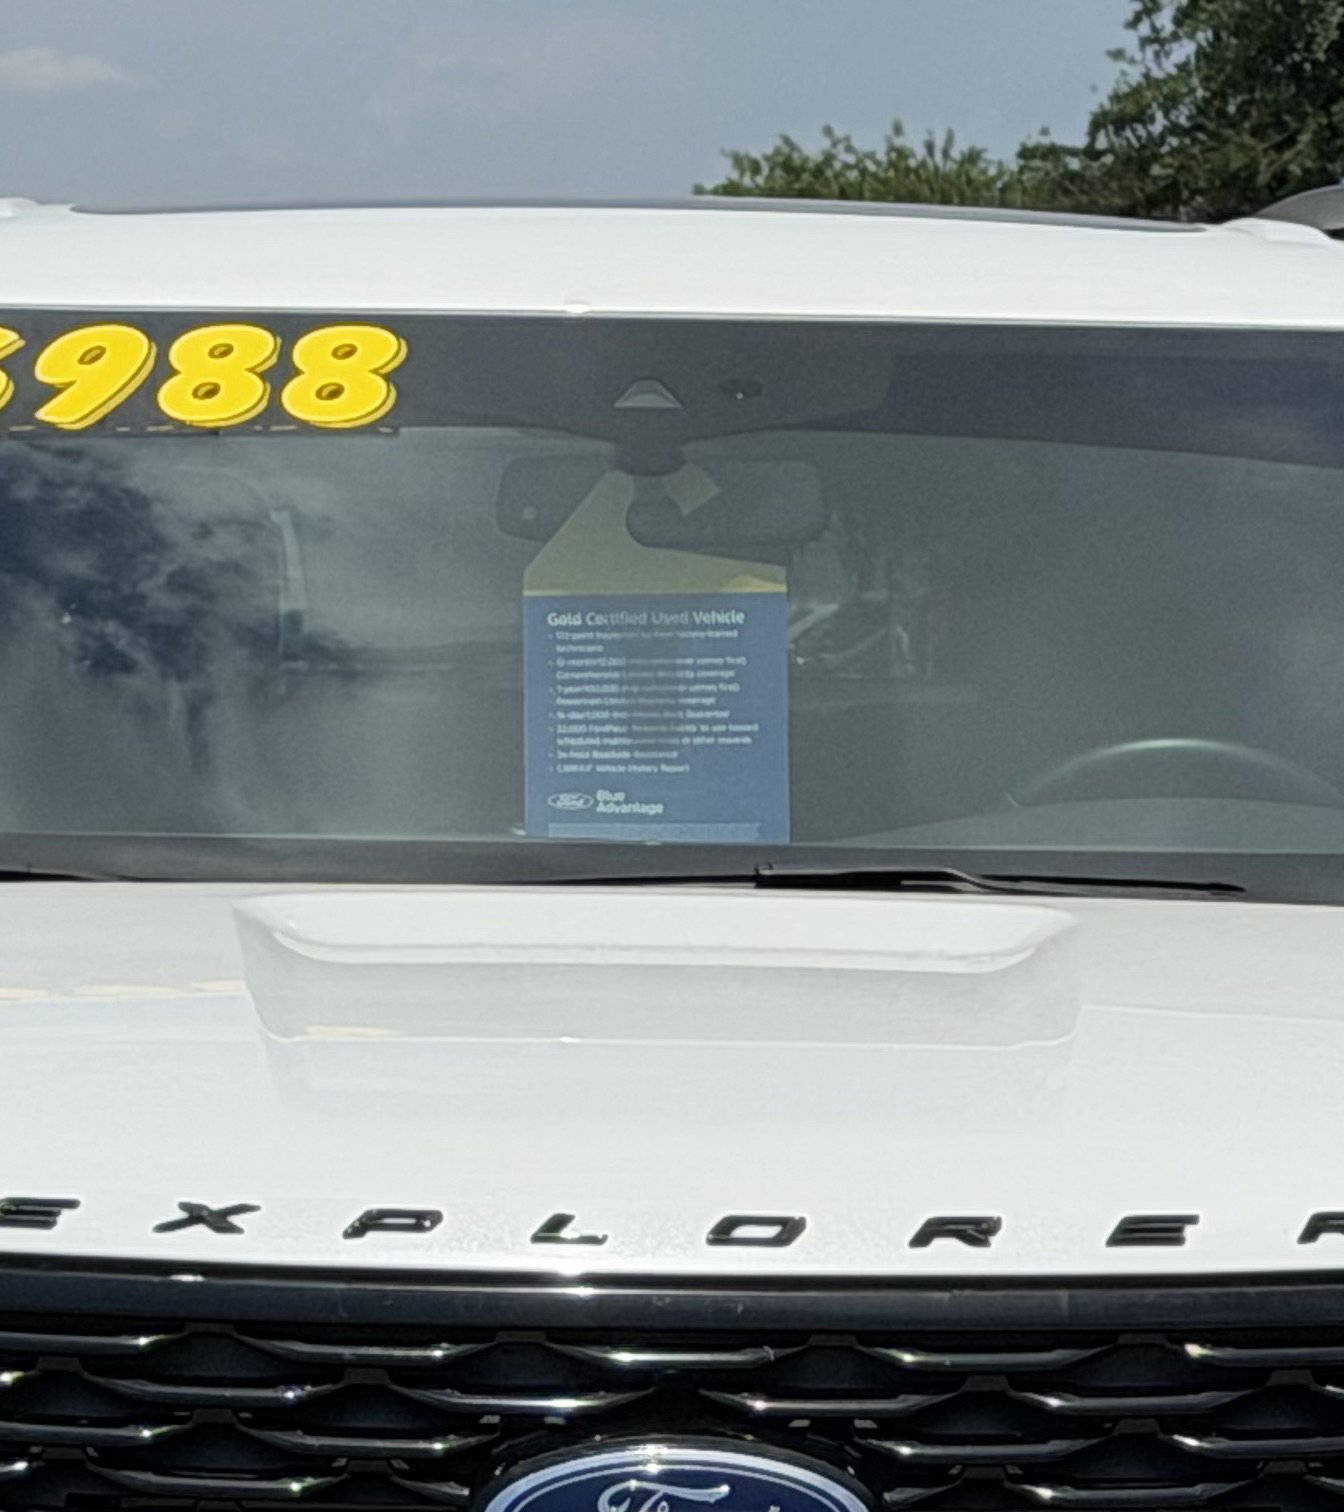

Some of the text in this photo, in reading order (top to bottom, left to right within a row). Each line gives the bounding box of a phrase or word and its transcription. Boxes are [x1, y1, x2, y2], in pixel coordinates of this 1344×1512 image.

[547, 608, 746, 627] Gold Certified Used Vehicle
[596, 789, 626, 802] Blue
[596, 801, 665, 815] Advantage
